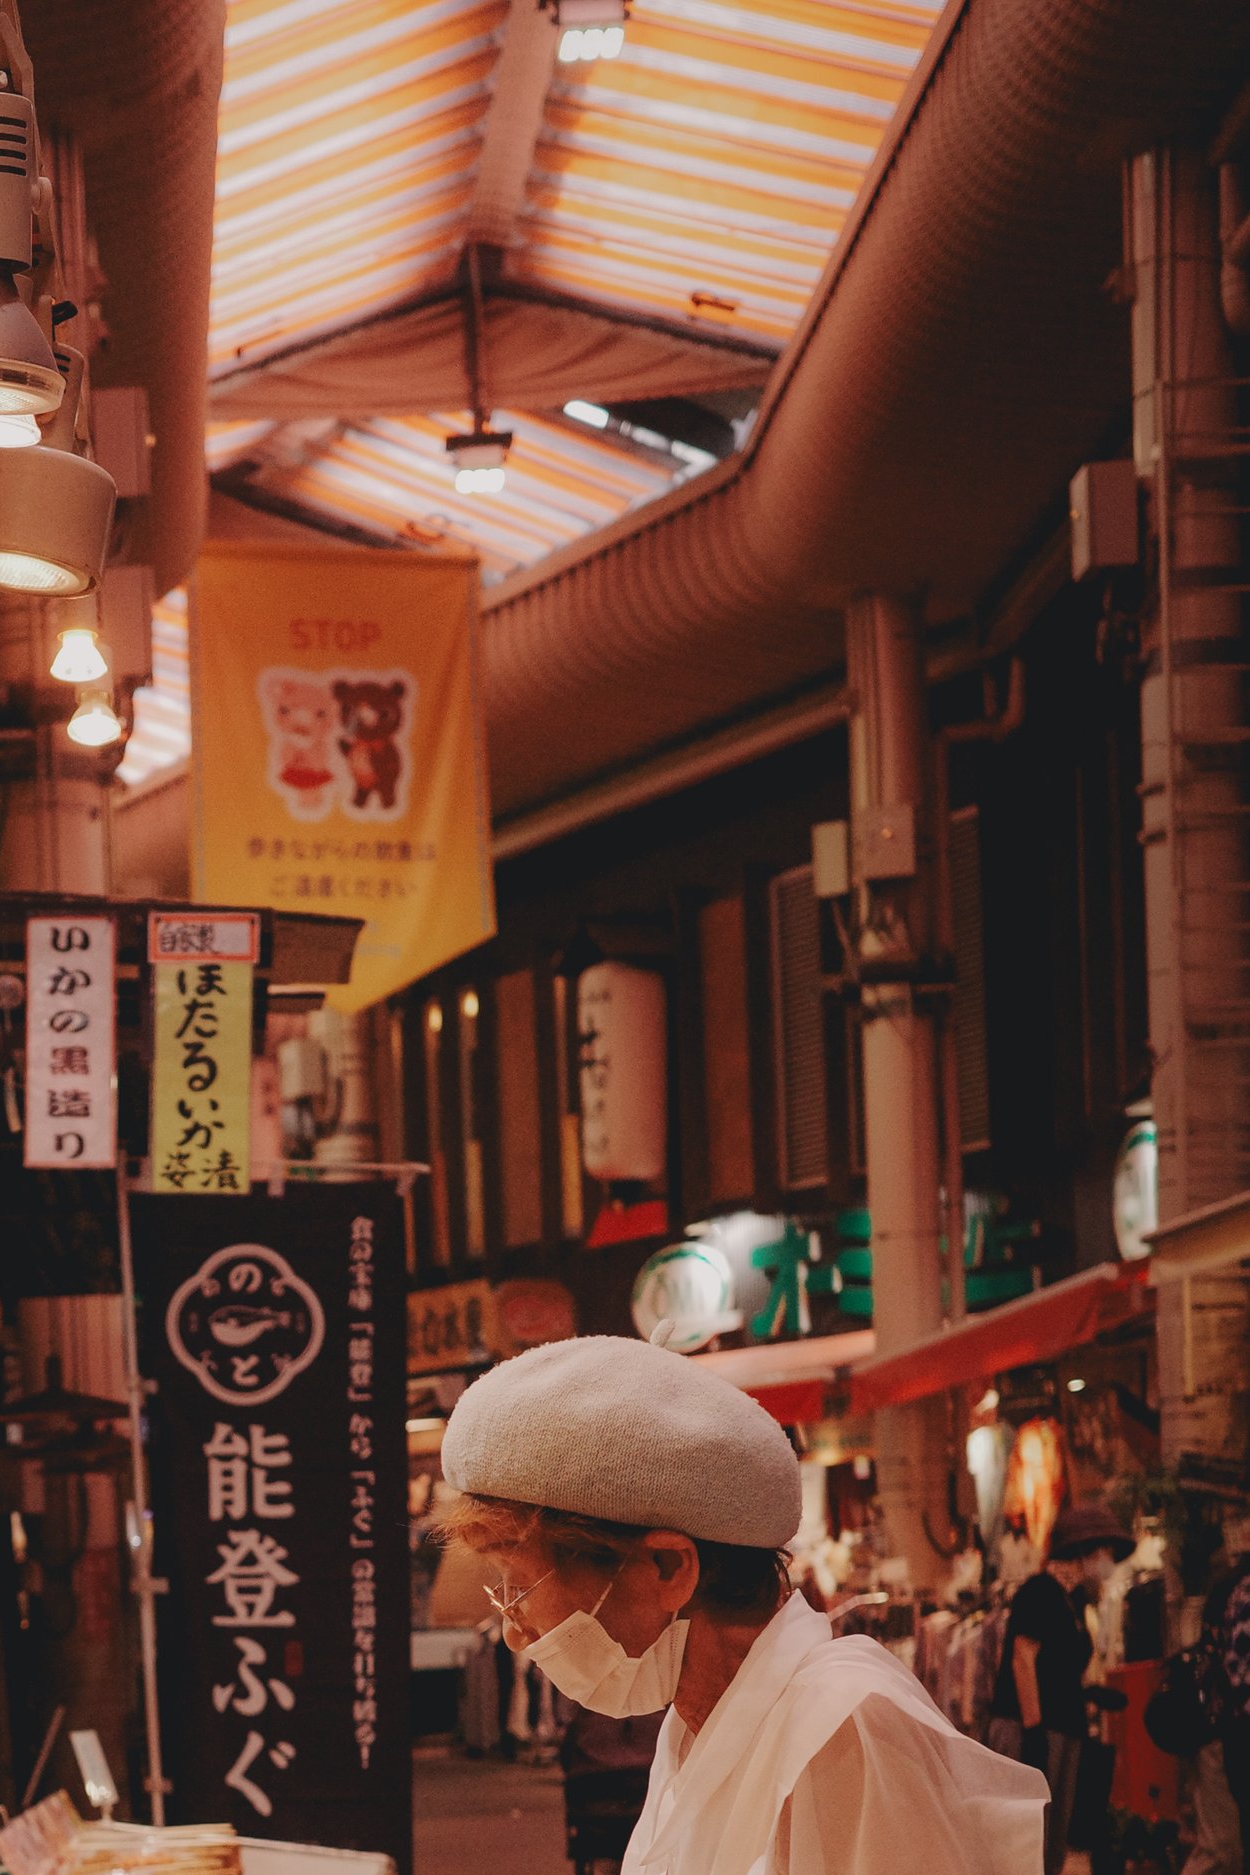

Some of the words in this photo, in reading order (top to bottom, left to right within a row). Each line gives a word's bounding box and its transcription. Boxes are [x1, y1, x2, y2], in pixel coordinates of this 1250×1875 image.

[289, 617, 383, 652] STOP
[48, 925, 93, 1160] いかの黒造り
[174, 963, 228, 1149] ほたるいか
[203, 1421, 299, 1817] 能登ふぐ
